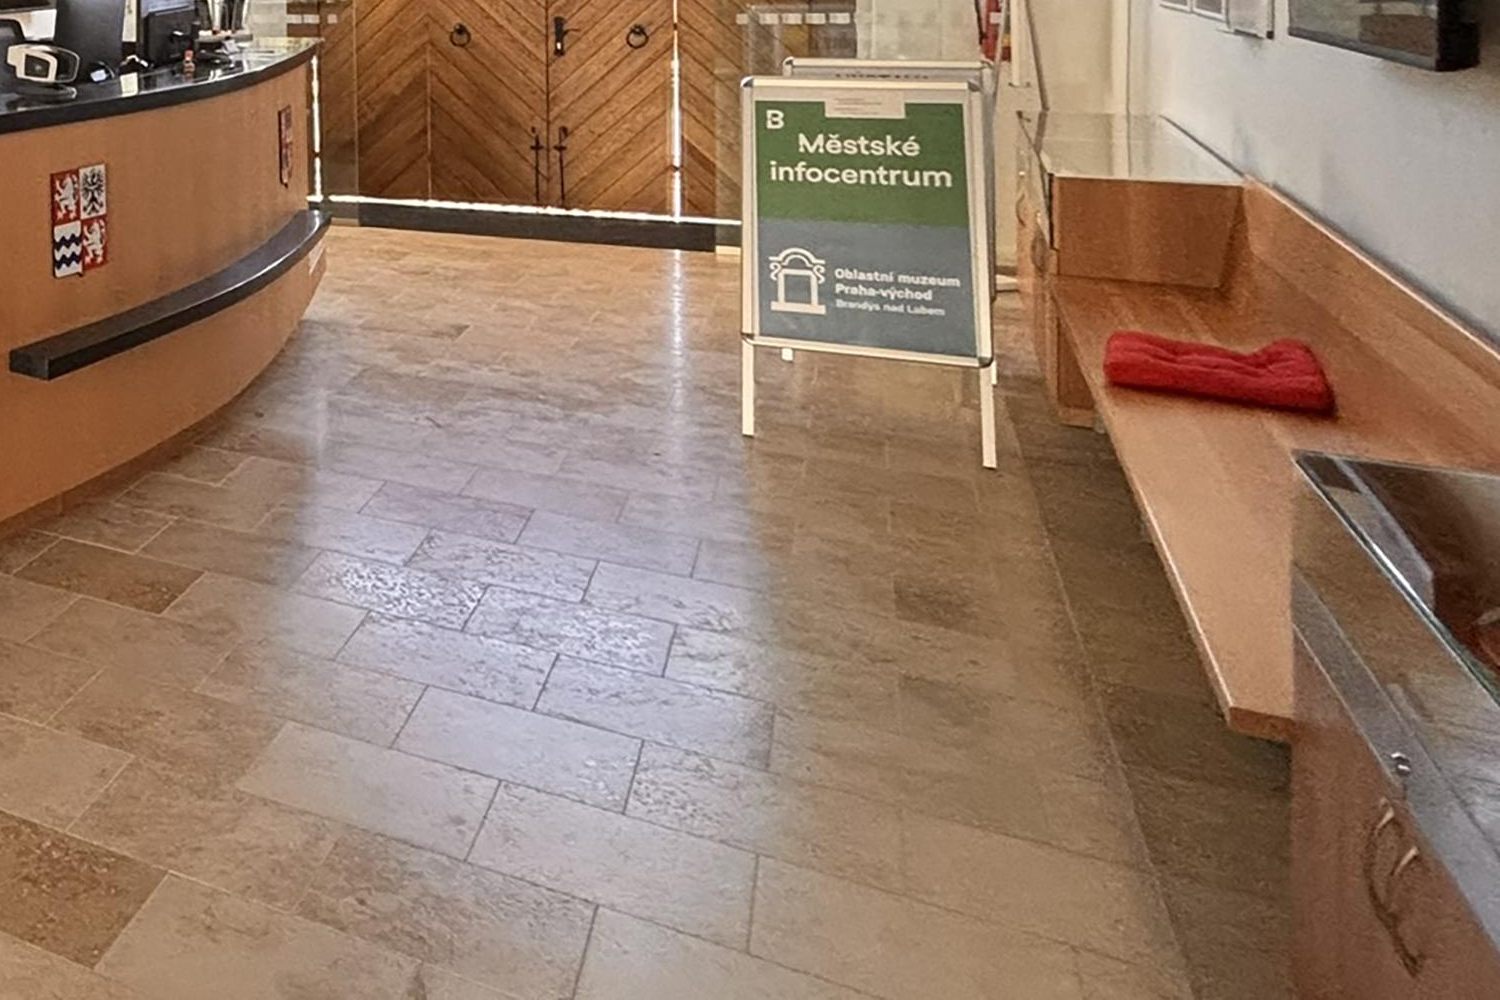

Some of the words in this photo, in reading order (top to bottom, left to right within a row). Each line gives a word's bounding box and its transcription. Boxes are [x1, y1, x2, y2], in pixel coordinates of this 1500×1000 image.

[798, 133, 921, 157] Městské
[769, 160, 953, 187] infocentrum
[835, 268, 894, 282] Oblastní
[898, 274, 961, 287] muzeum
[835, 283, 933, 301] Praha-východ
